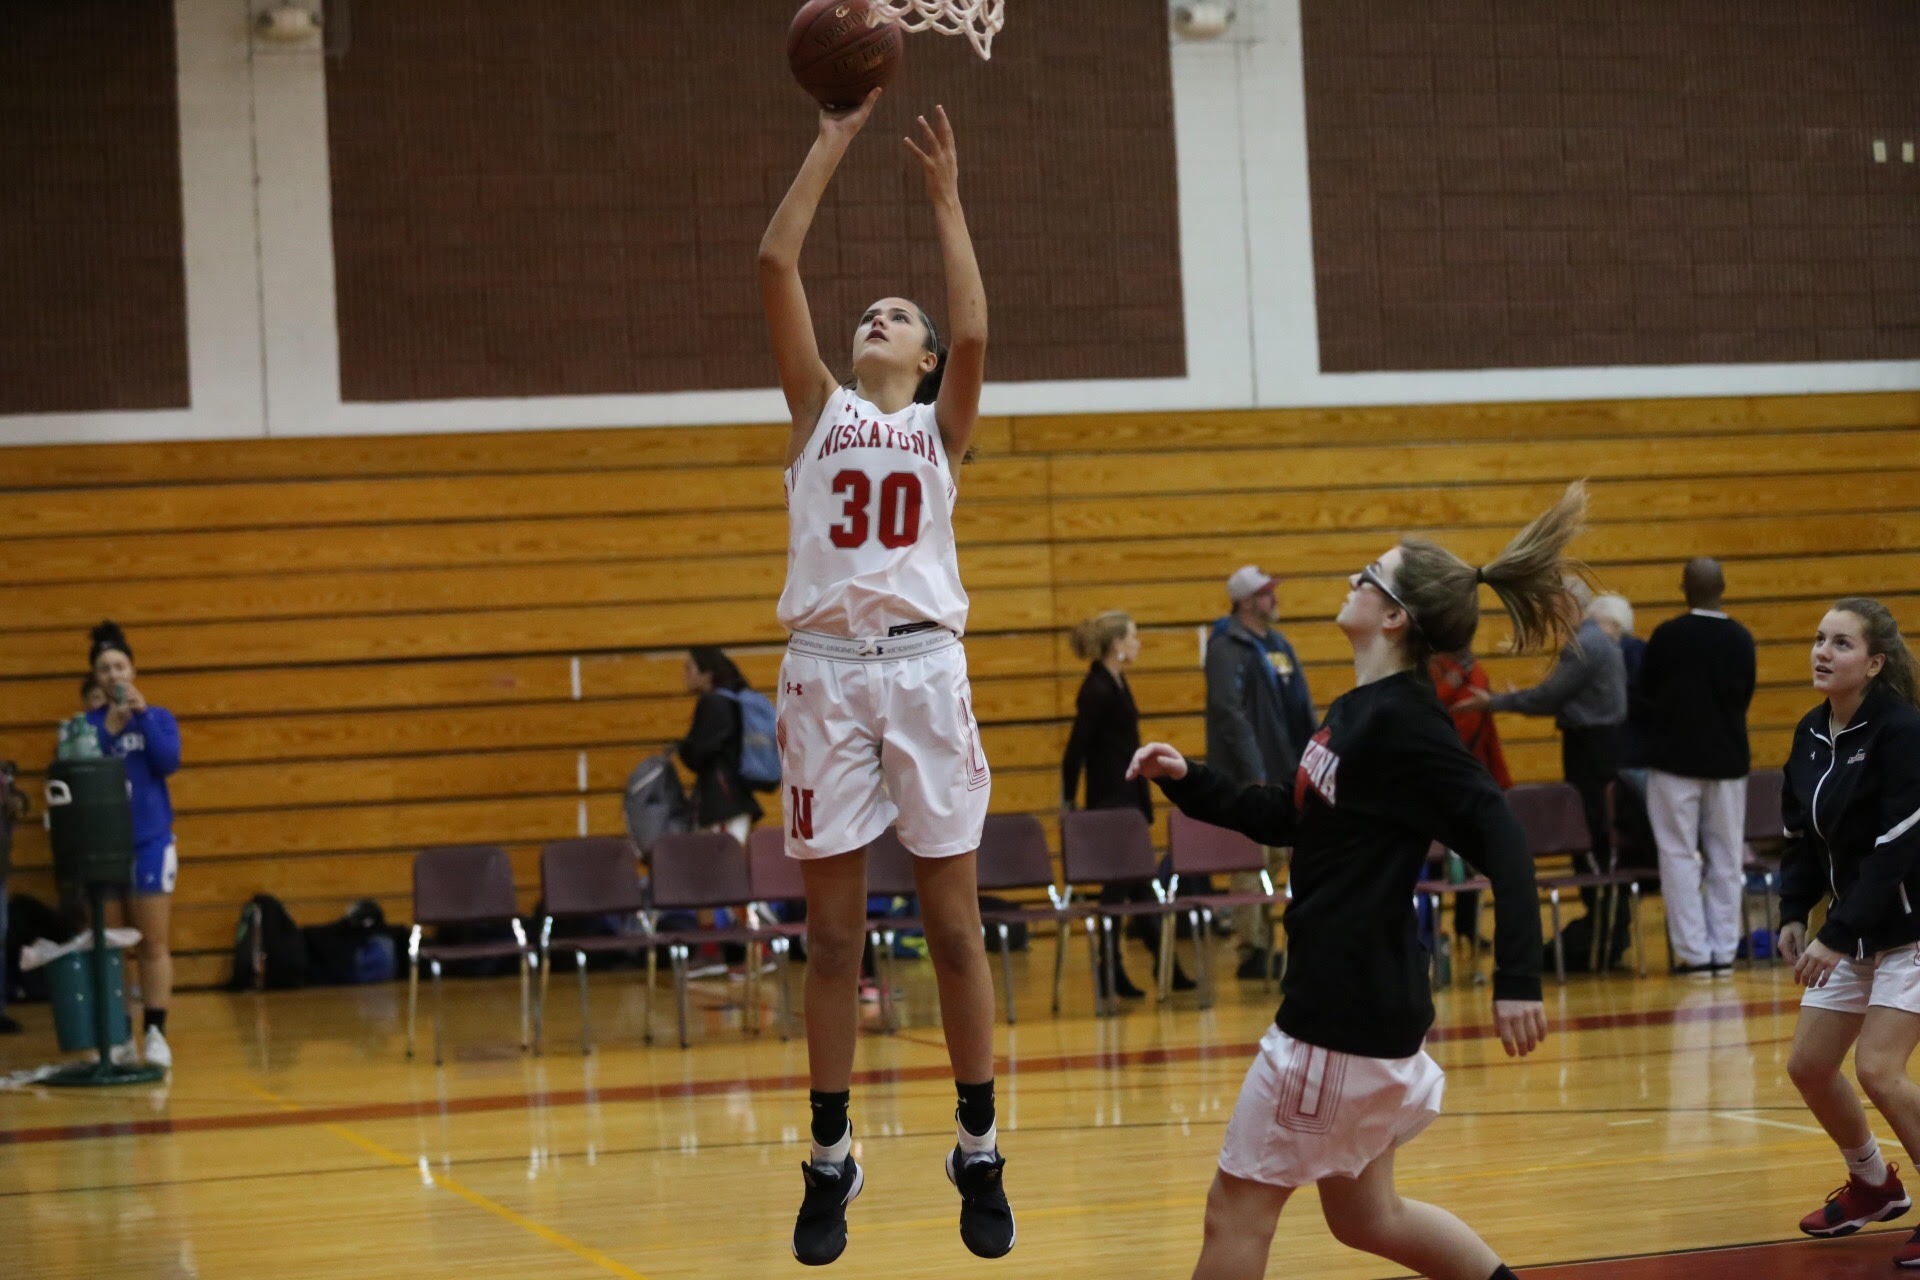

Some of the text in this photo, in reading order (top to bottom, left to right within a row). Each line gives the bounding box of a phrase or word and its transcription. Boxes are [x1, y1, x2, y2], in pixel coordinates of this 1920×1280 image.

[818, 419, 939, 467] NISKAYUNA
[830, 468, 922, 550] 30
[791, 786, 814, 839] N
